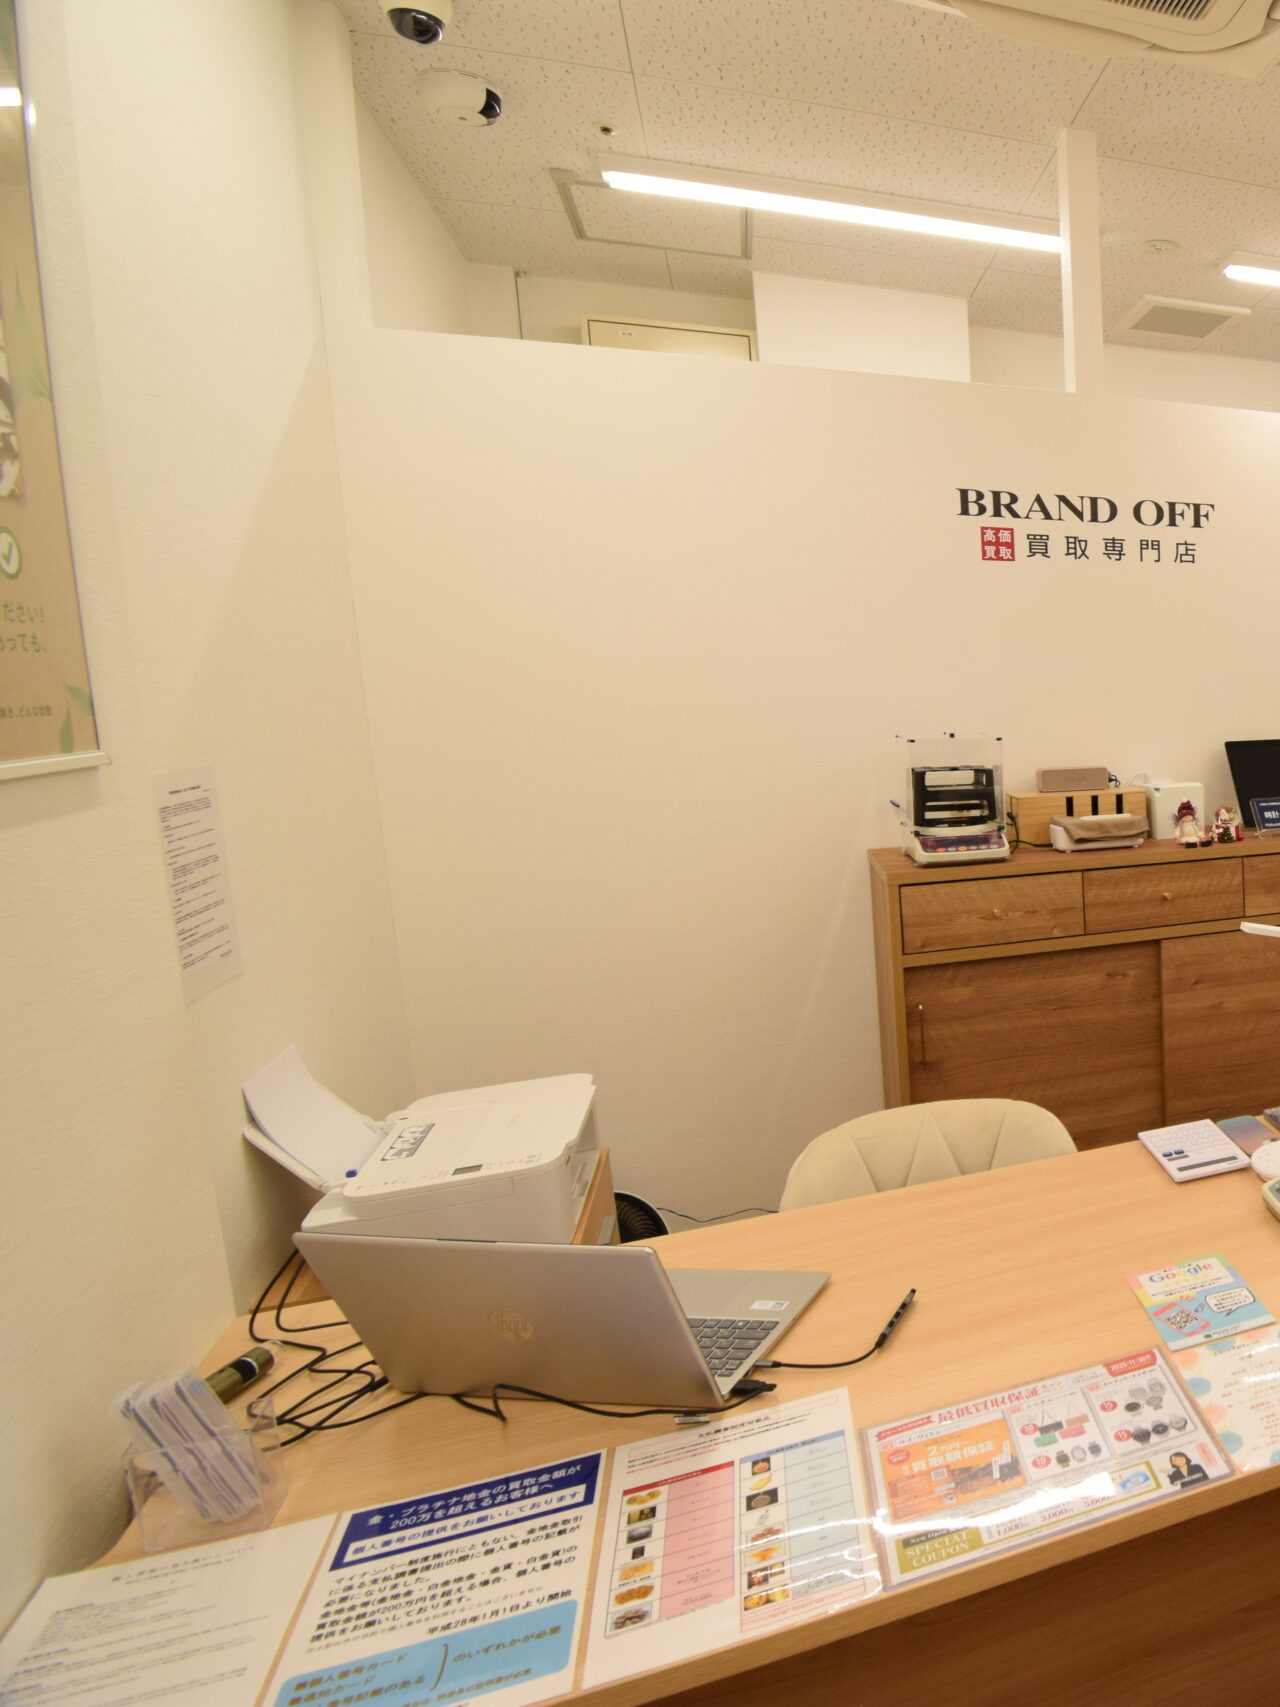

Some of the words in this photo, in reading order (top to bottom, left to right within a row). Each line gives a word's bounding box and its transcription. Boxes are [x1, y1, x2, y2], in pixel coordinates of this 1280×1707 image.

[955, 488, 1118, 523] BRAND
[1133, 500, 1215, 528] OFF
[983, 528, 1012, 543] 高価
[1026, 534, 1196, 564] 買取専門店
[983, 545, 1013, 560] 買取
[1149, 1264, 1213, 1283] Google
[366, 1464, 582, 1526] 金・プラチナ地金の買取金額が
[390, 1484, 553, 1530] 200万を超えるお客様へ
[351, 1490, 581, 1556] 個人番号の提供をお願いしております
[905, 1532, 972, 1559] SPECIAL
[912, 1541, 970, 1568] COUPON
